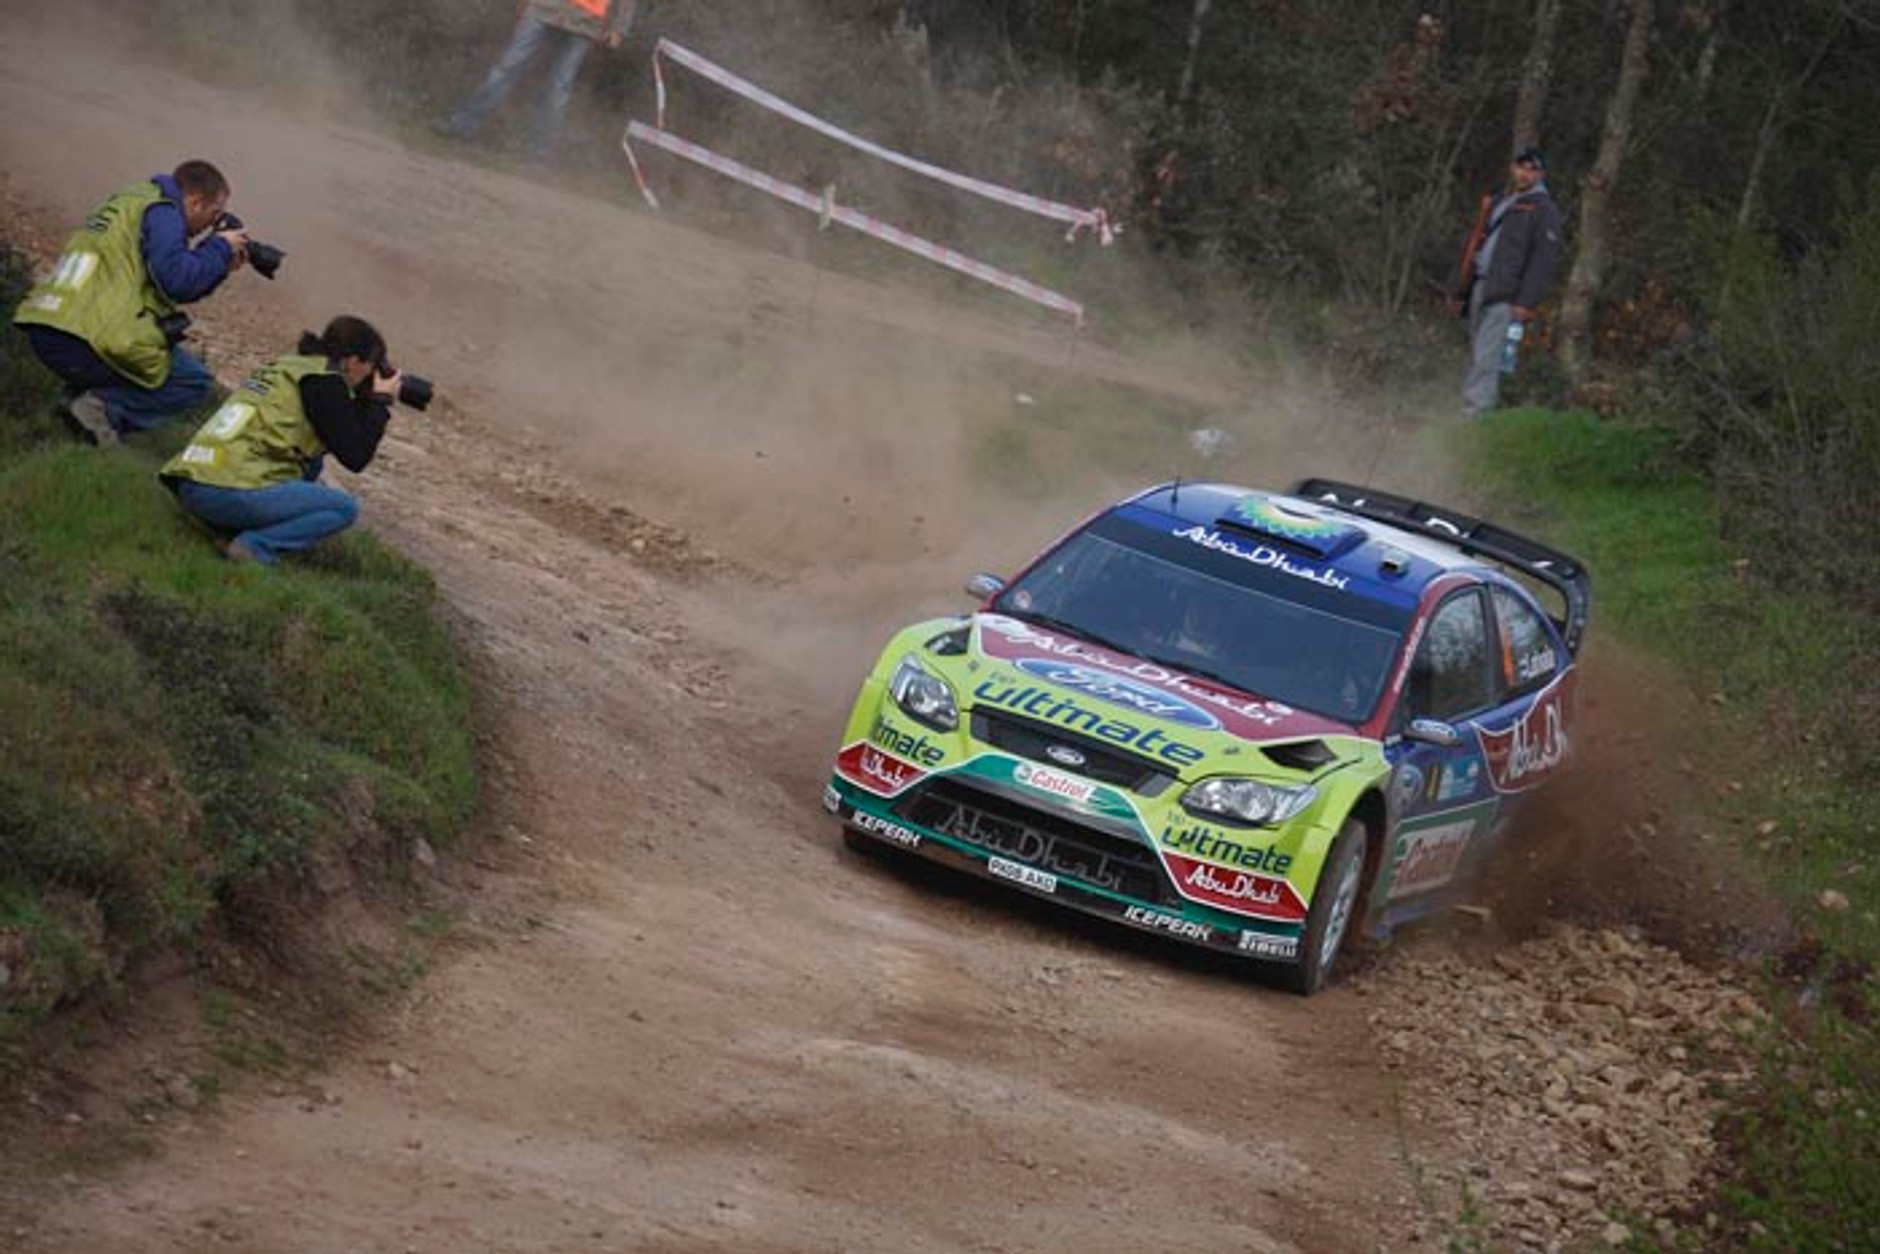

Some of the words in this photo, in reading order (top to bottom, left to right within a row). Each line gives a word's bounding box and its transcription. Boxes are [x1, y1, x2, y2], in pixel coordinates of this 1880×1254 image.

[1047, 667, 1188, 714] Ford
[973, 681, 1204, 767] ultimate
[1031, 770, 1089, 799] Castrol
[1162, 825, 1293, 874] ultimate
